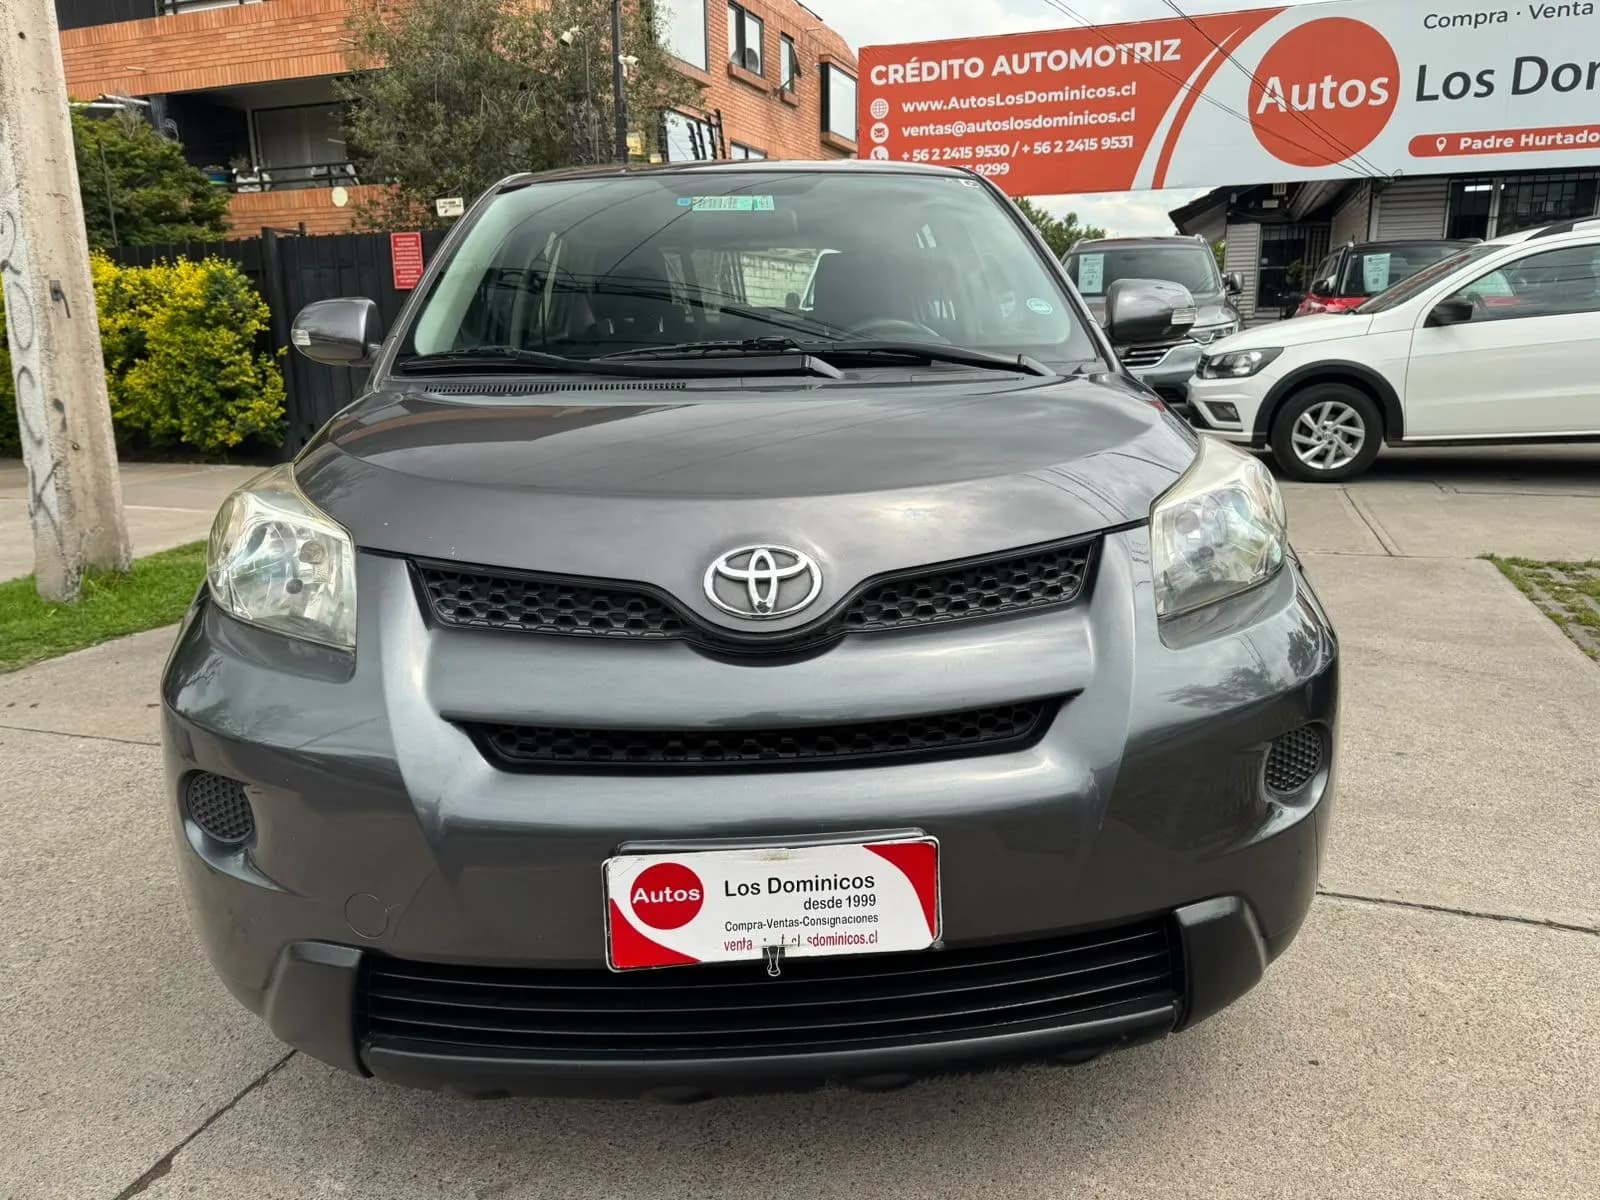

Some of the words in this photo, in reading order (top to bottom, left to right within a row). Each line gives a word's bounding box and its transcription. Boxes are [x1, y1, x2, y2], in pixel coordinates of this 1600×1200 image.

[1423, 10, 1508, 29] Compra
[1528, 1, 1594, 20] Venta
[870, 56, 985, 86] CRÉDITO
[992, 38, 1182, 77] AUTOMOTRIZ
[1256, 74, 1389, 115] Autos
[1415, 64, 1495, 102] Los
[902, 82, 1136, 113] www.AutosLosDominicos.cl
[902, 108, 1136, 138] ventas@autoslosdominicos.cl
[912, 148, 929, 161] 56
[931, 148, 940, 161] 2
[943, 146, 973, 160] 2415
[975, 144, 1010, 158] 9530
[1033, 141, 1051, 155] 56
[1053, 140, 1063, 153] 2
[1065, 138, 1098, 153] 2415
[1101, 135, 1134, 150] 9531
[1460, 134, 1514, 151] Padre
[1520, 129, 1600, 147] Hurtado
[975, 162, 1010, 176] 9299
[632, 887, 701, 904] Autos
[724, 880, 761, 897] Los
[768, 874, 875, 894] Dominicos
[803, 896, 842, 911] desde
[845, 894, 877, 909] 1999
